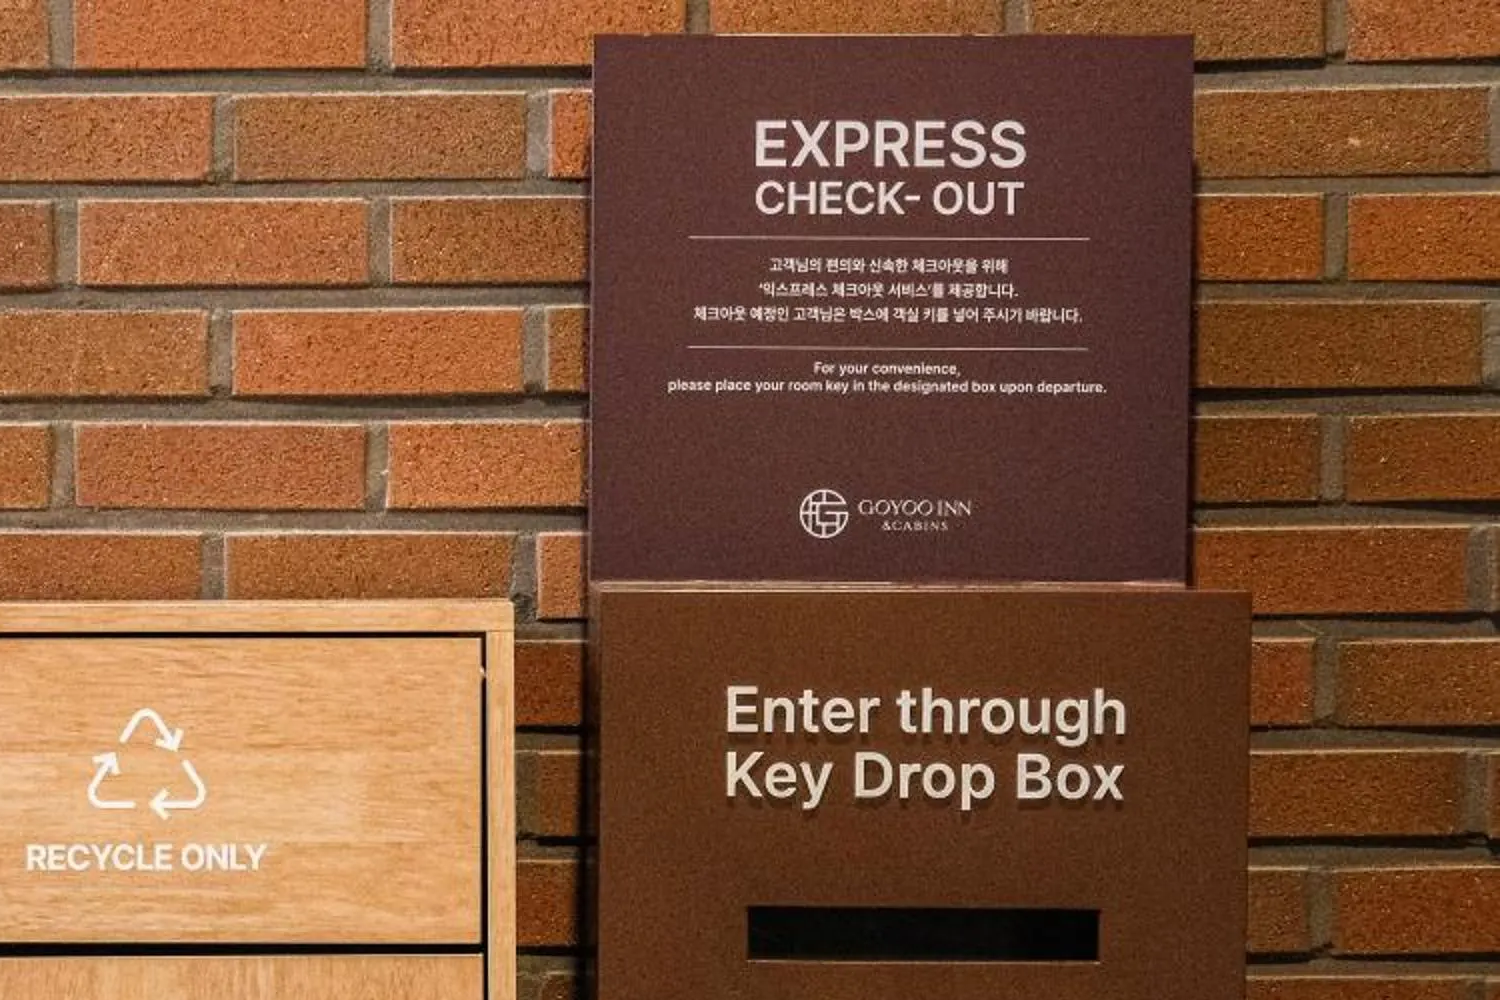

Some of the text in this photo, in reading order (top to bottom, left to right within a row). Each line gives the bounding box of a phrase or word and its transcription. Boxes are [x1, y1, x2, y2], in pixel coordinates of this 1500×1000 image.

[755, 119, 1027, 169] EXPRESS
[769, 257, 1009, 275] 고객님의 편의와 신속한 체크아웃을 위해
[831, 282, 884, 299] 체크아웃
[947, 283, 1019, 299] 제공합니다.
[693, 305, 1083, 325] 체크아웃 예정인 고객님은 박스에 객실 키를 넣어 주시기 바랍니다.
[813, 361, 961, 377] For your convenience,
[667, 379, 1107, 396] please place your room key in the designated box upon departure.
[857, 499, 971, 517] GOYOO INN
[881, 520, 949, 533] &CABINS
[726, 685, 1126, 748] Enter through
[726, 751, 1125, 811] Key Drop Box
[26, 843, 268, 871] RECYCLE ONLY
